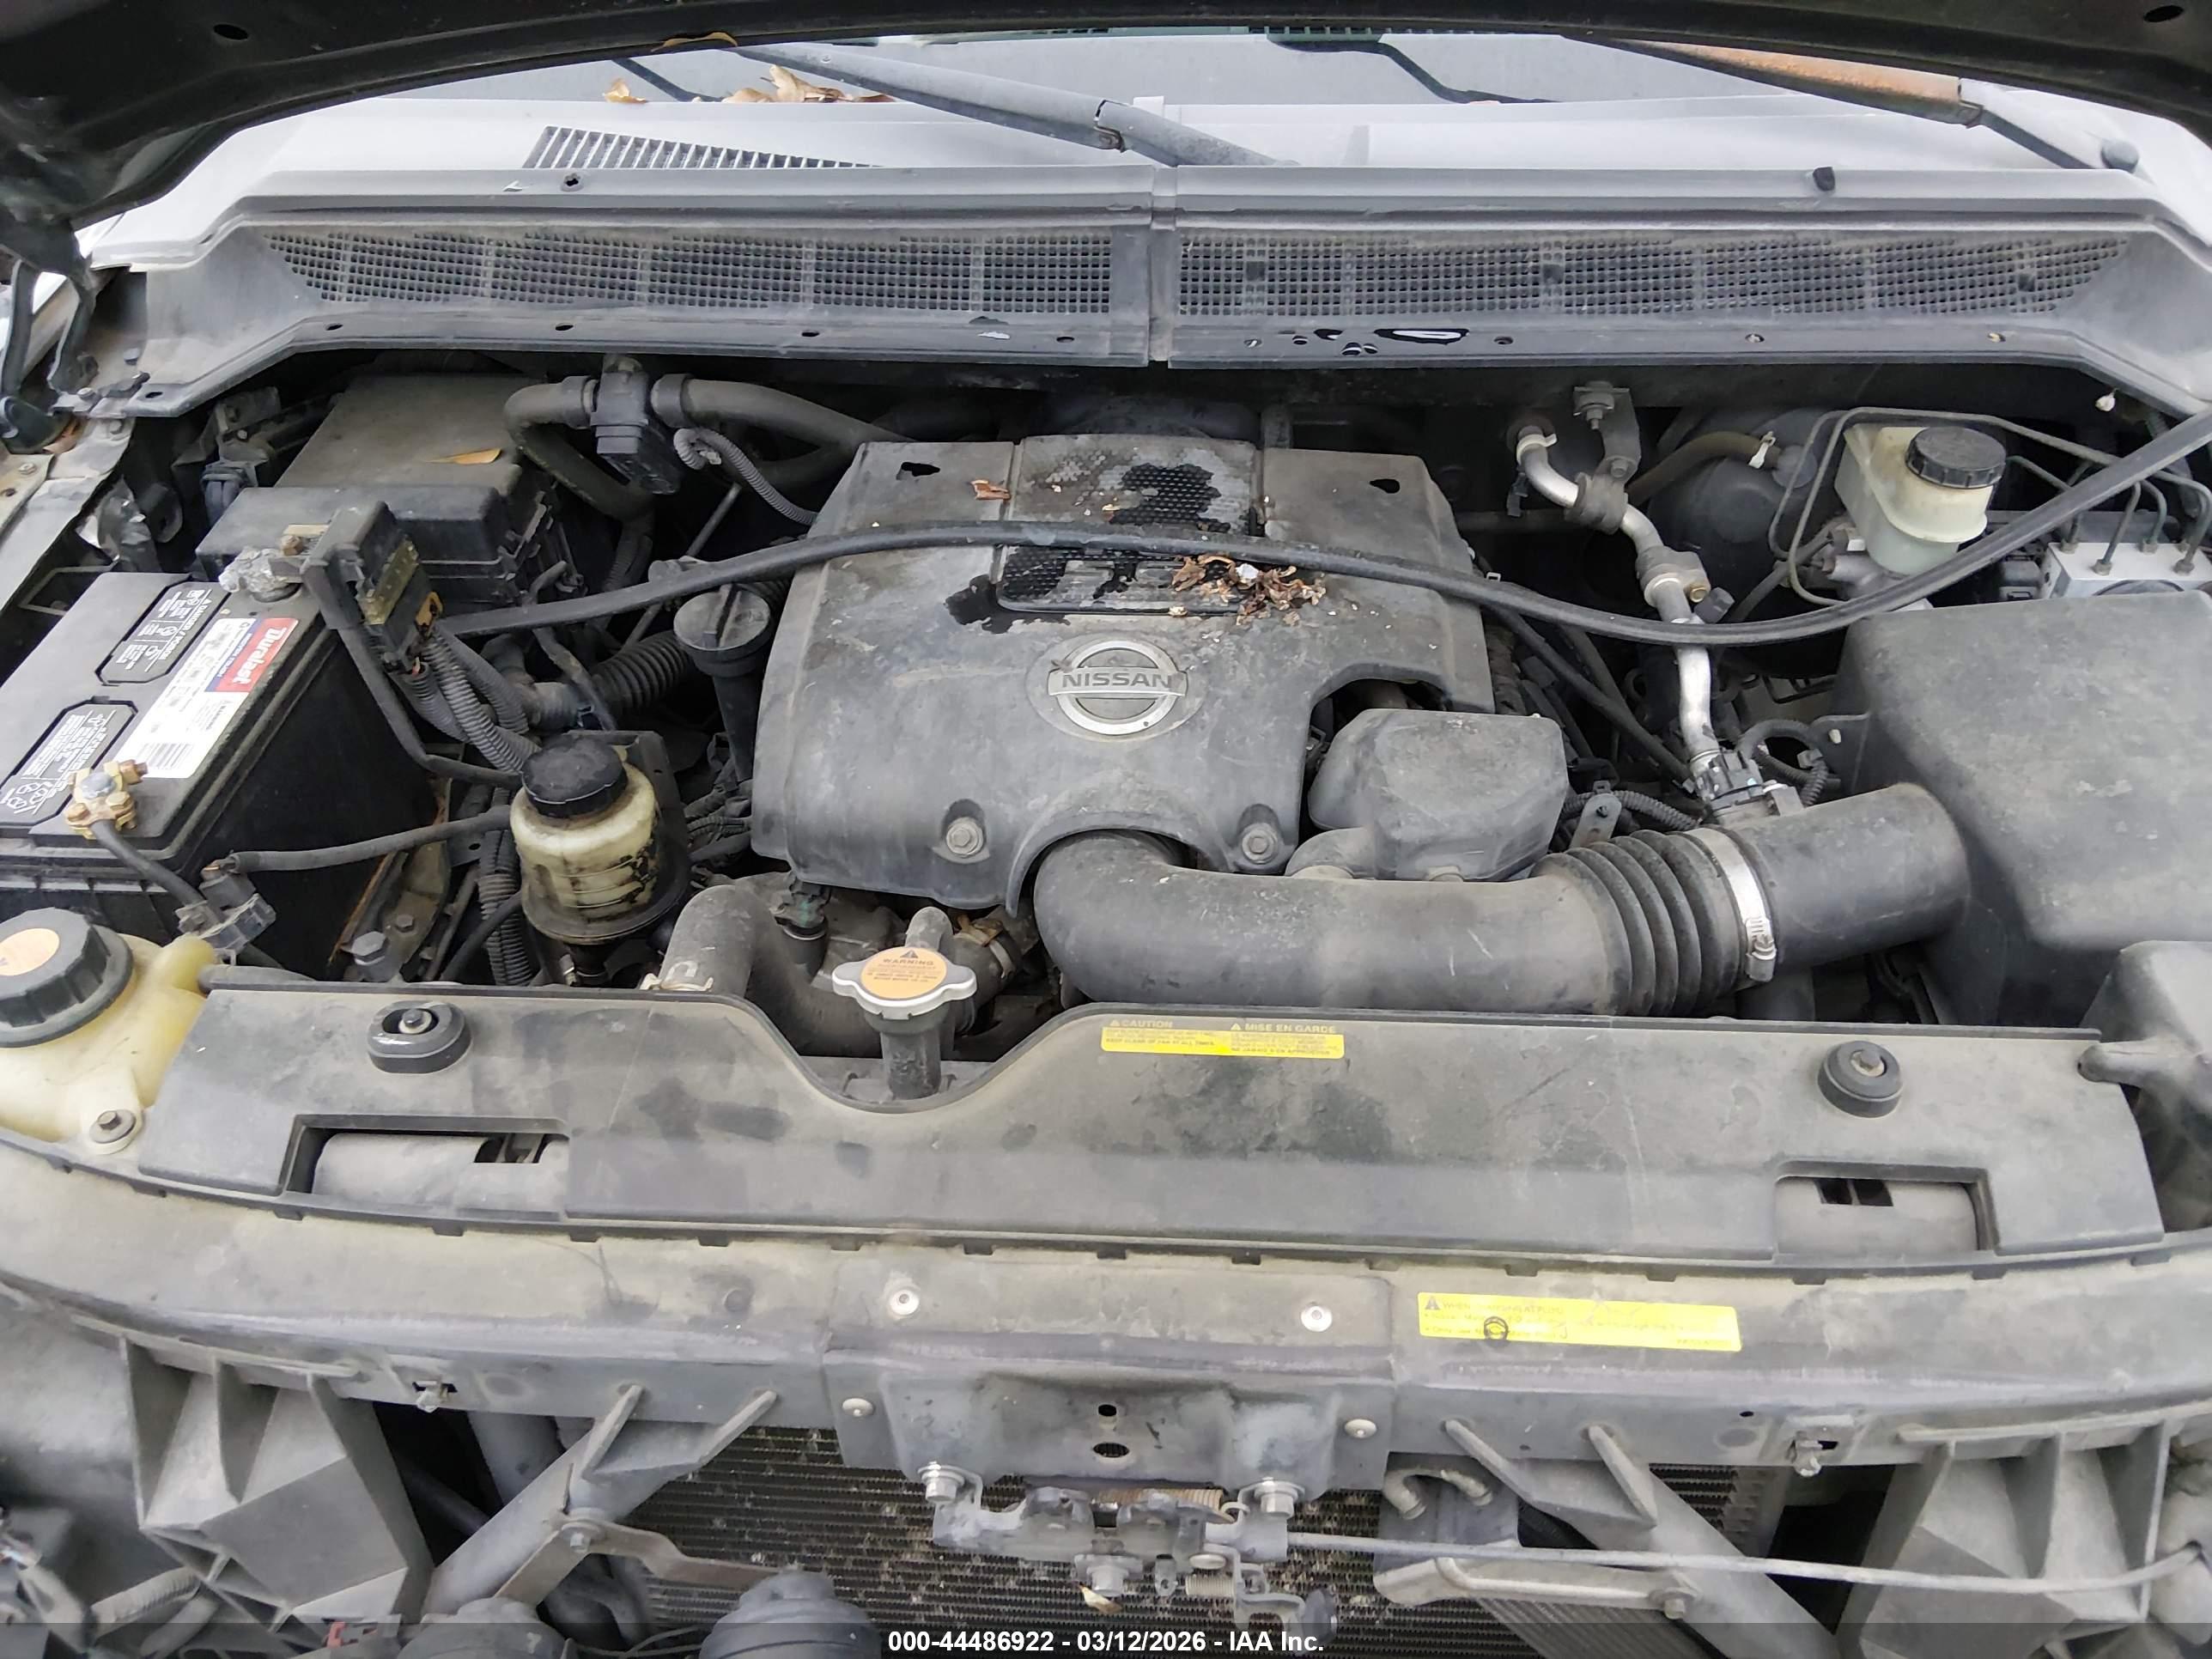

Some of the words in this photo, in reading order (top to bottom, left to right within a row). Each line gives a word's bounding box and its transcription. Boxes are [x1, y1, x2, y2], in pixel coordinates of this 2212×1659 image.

[182, 605, 208, 630] DANGER
[232, 628, 288, 684] Duralast
[1061, 672, 1172, 688] NISSAN
[1121, 1019, 1174, 1029] CAUTION
[1244, 1023, 1273, 1031] MISE
[1275, 1024, 1292, 1032] EN
[1295, 1024, 1336, 1034] GARDE
